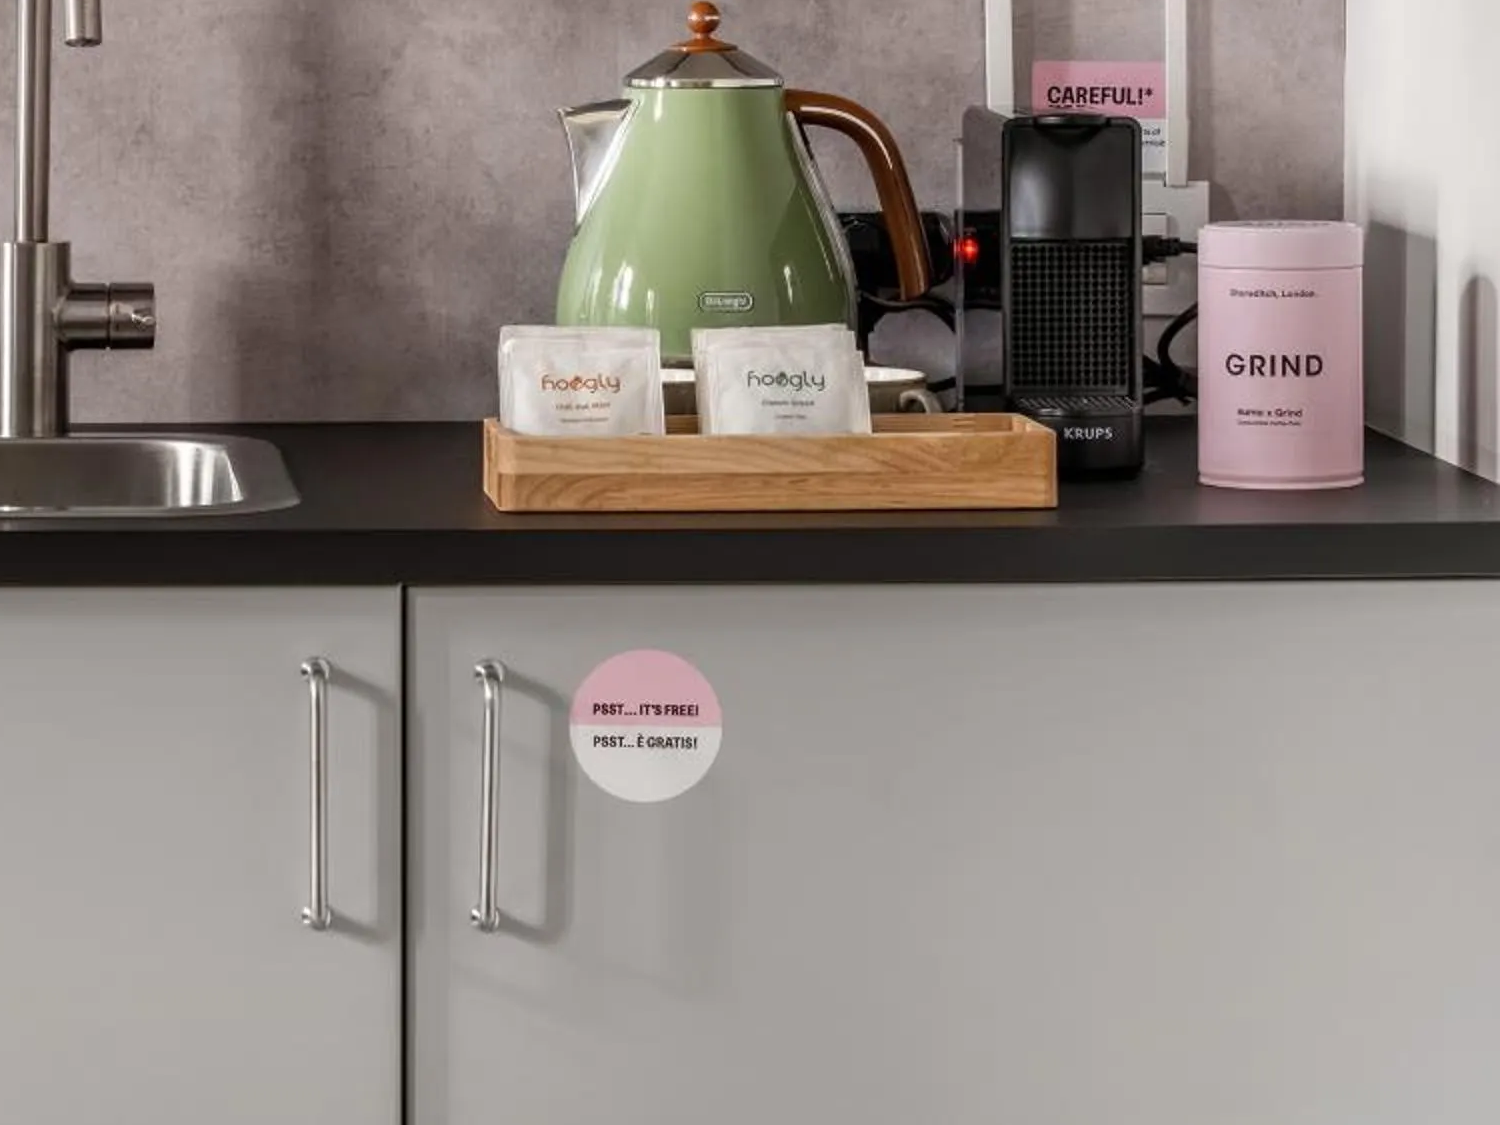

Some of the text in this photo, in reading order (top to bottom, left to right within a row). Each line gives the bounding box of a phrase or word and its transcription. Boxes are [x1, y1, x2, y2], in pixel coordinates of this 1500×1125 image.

[1225, 354, 1324, 377] GRIND
[541, 373, 621, 394] hoogly
[747, 370, 826, 392] hoogly
[1063, 426, 1113, 440] KRUPS
[593, 703, 699, 716] PSST... IT'S FREE!
[593, 732, 698, 749] PSST... È GRATIS!
